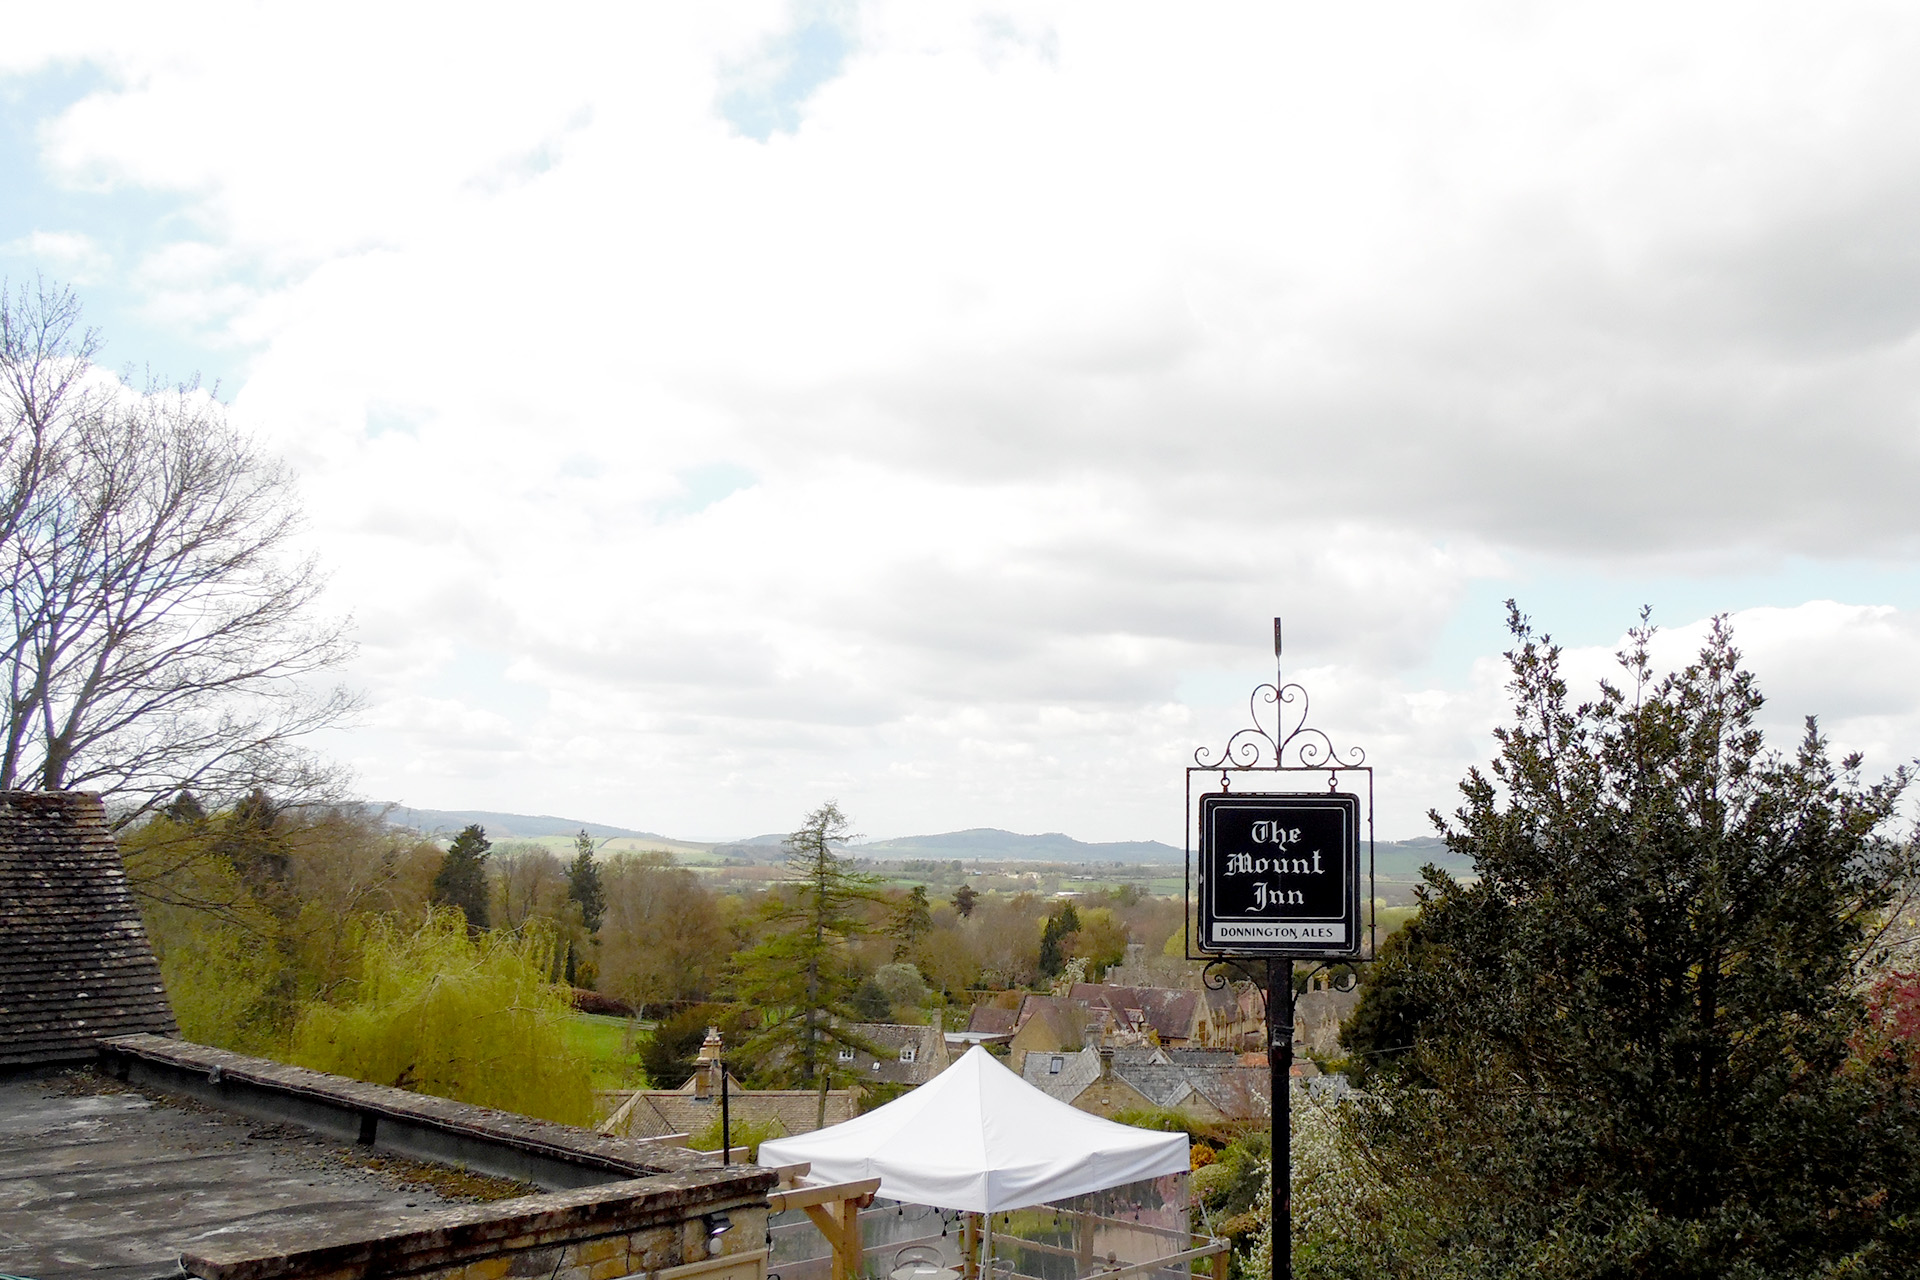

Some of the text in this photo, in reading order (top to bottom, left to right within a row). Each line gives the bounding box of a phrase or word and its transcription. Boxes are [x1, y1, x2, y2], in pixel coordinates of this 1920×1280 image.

[1251, 819, 1302, 852] The
[1223, 849, 1325, 876] Mount
[1245, 882, 1304, 912] Inn
[1220, 927, 1333, 938] DONNINGTON ALES
